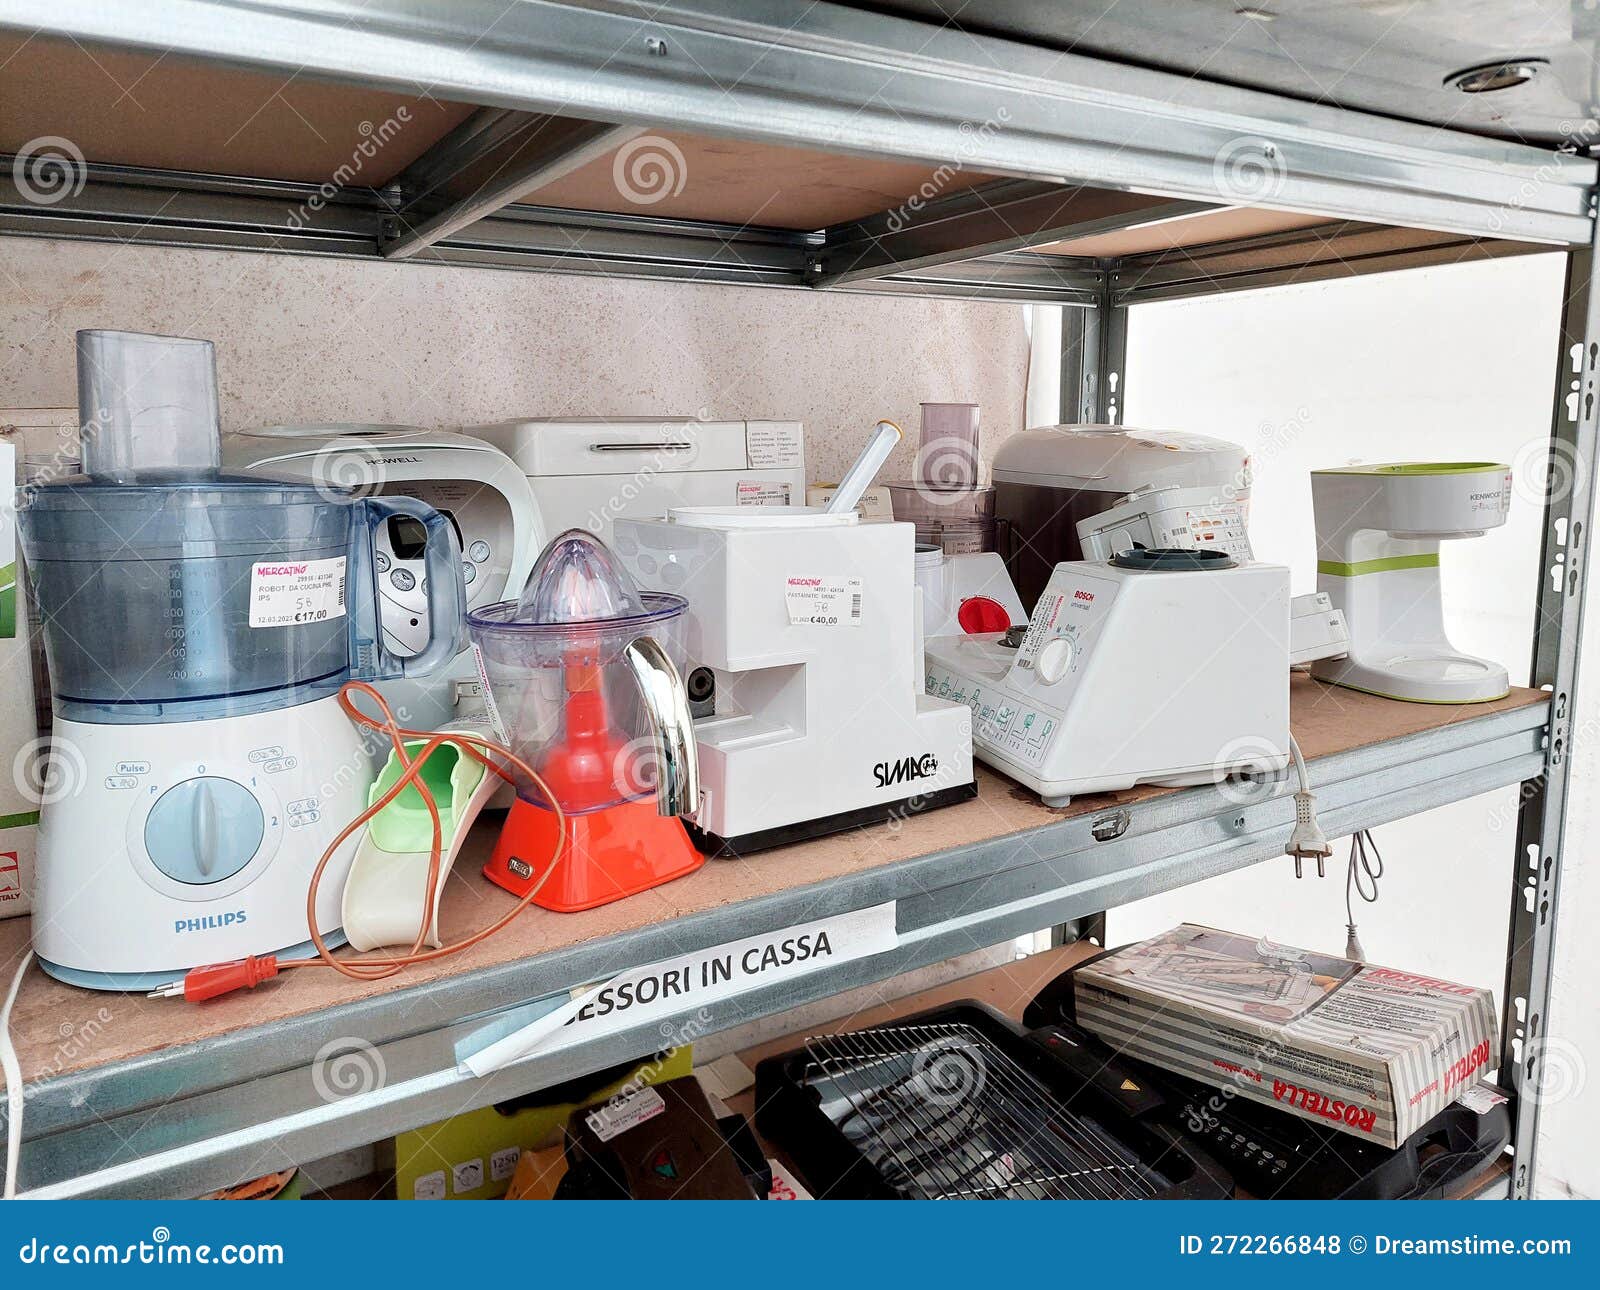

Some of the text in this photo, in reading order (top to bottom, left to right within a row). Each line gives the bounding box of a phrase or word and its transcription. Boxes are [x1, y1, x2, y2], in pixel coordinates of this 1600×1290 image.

[365, 456, 423, 466] HOWELL
[257, 564, 308, 577] MERCATINO
[258, 585, 285, 593] ROBOT
[1074, 590, 1095, 602] BOSCH
[294, 609, 327, 622] €17,00
[810, 616, 838, 625] €40,00
[120, 764, 145, 773] Pulse
[873, 753, 931, 788] SIMAC
[251, 777, 257, 787] 1
[150, 785, 158, 794] P
[271, 817, 278, 826] 2
[175, 910, 247, 933] PHILIPS
[564, 931, 833, 1027] ESSORI IN CASSA
[1368, 968, 1475, 996] ROSTELLA
[1443, 1039, 1490, 1095] ROSTELLA
[1273, 1078, 1377, 1133] ROSTELLA
[493, 1152, 519, 1168] 1250
